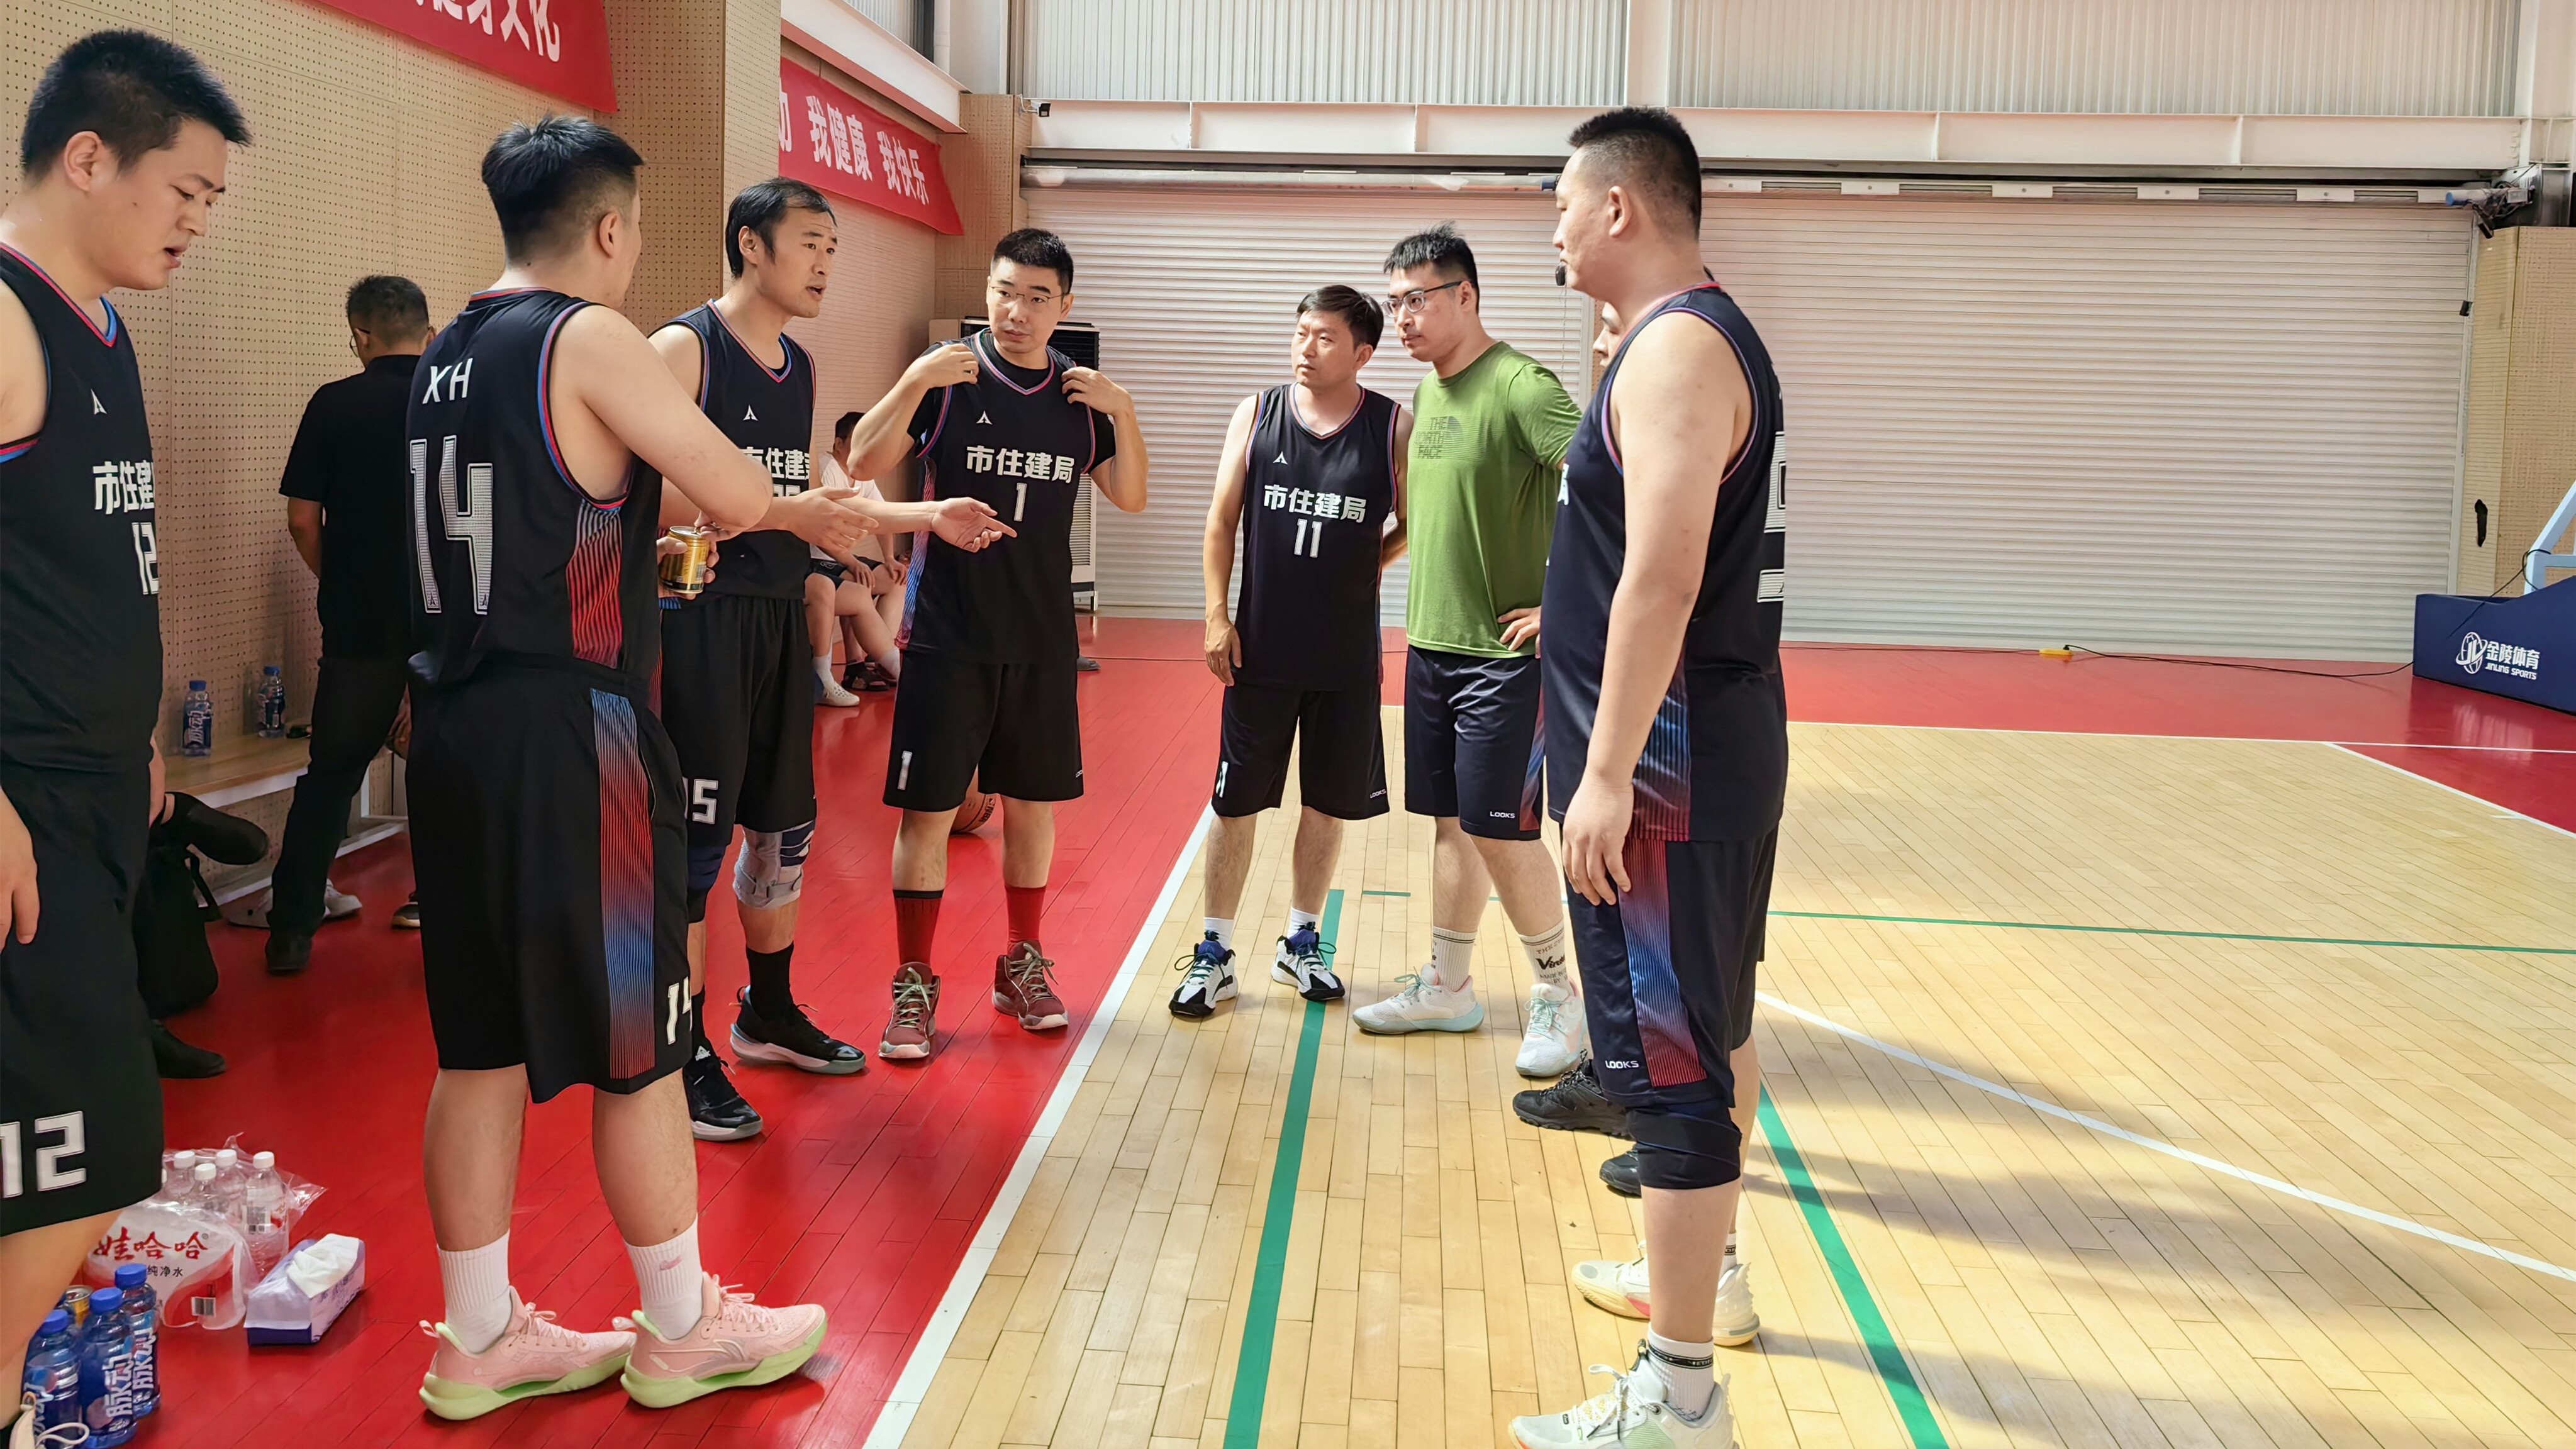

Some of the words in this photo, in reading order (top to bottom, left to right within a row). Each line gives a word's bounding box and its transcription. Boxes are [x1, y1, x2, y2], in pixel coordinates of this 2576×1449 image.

[806, 96, 873, 182] 我健康
[877, 131, 929, 205] 我快乐
[422, 358, 473, 404] XH
[1430, 416, 1447, 430] THE
[966, 445, 1075, 484] 市住建局
[1418, 445, 1443, 459] FACE
[92, 460, 155, 514] 市住建
[1013, 482, 1027, 522] 1
[1263, 484, 1367, 523] 市住建局
[410, 435, 493, 615] 14
[1293, 519, 1322, 558] 11
[2485, 641, 2540, 670] 金陵体育
[2511, 668, 2537, 680] SPORTS
[898, 750, 913, 791] 1
[683, 776, 718, 824] 5
[1490, 811, 1515, 819] LOOKS
[1605, 1060, 1639, 1069] LOOKS
[0, 1111, 87, 1197] 12
[93, 1226, 208, 1260] 娃哈哈
[147, 1264, 183, 1277] 纯净水
[101, 1353, 133, 1418] 脉动
